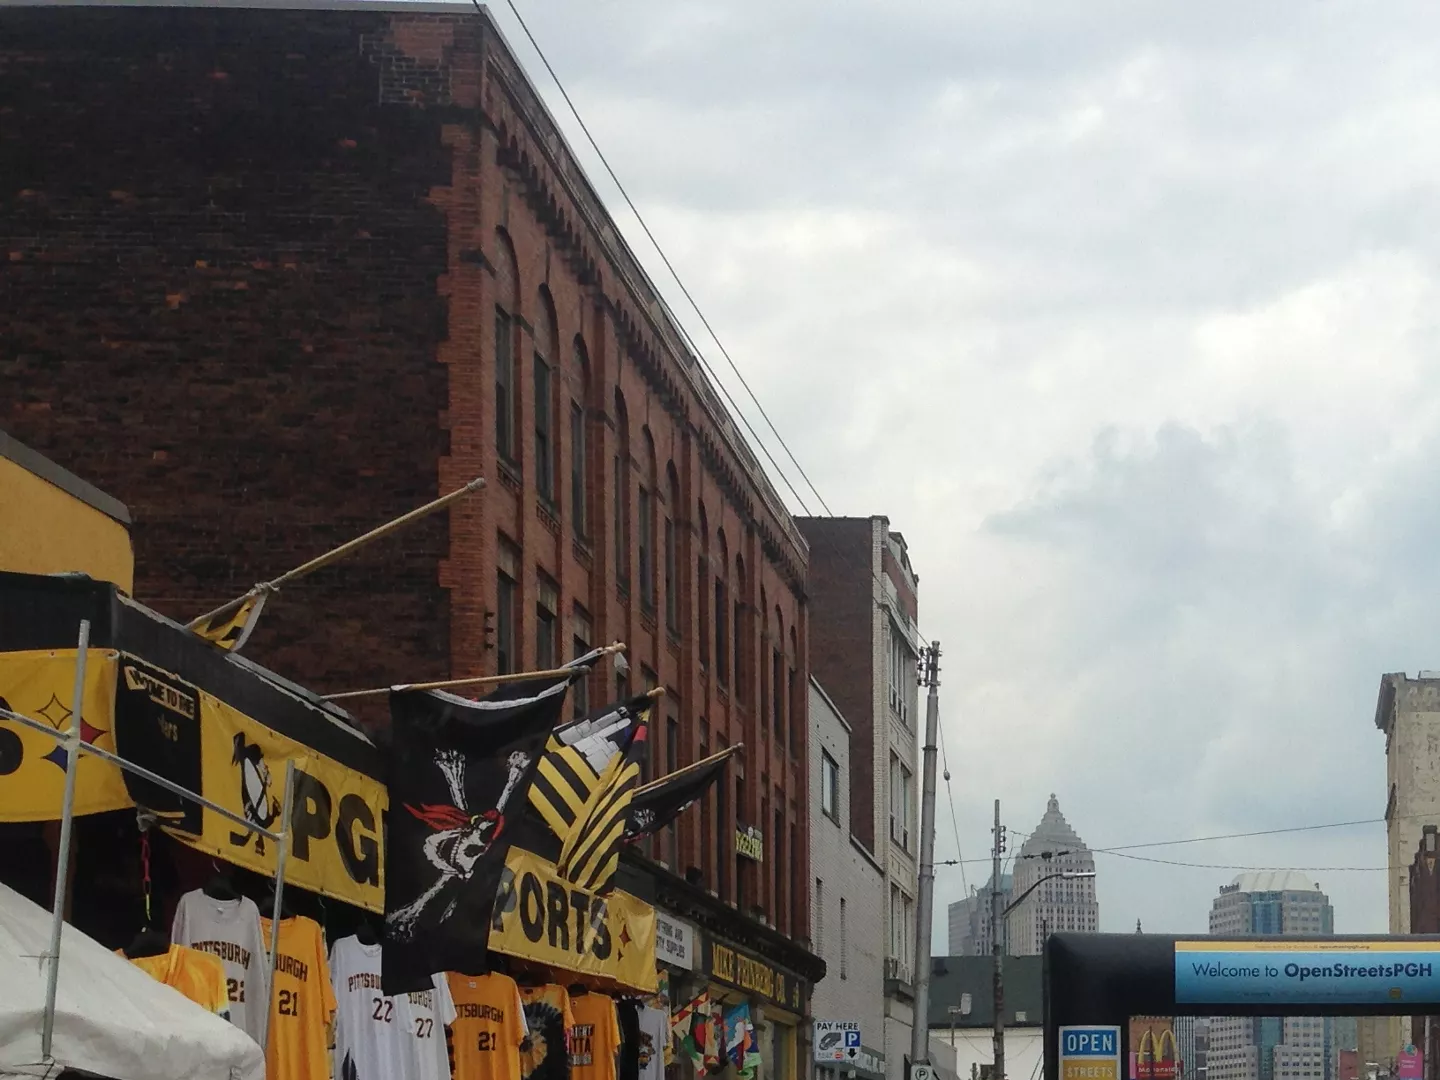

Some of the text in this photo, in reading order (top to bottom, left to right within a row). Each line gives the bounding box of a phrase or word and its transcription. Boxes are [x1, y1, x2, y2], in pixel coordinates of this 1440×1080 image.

[1192, 962, 1433, 981] Welcome to OpenStreetsPGH
[278, 989, 298, 1017] 21
[372, 997, 394, 1023] 22
[816, 1022, 859, 1031] PAY HERE
[477, 1031, 497, 1052] 21
[848, 1032, 859, 1046] P
[1067, 1033, 1113, 1052] OPEN
[1067, 1066, 1113, 1079] STREETS
